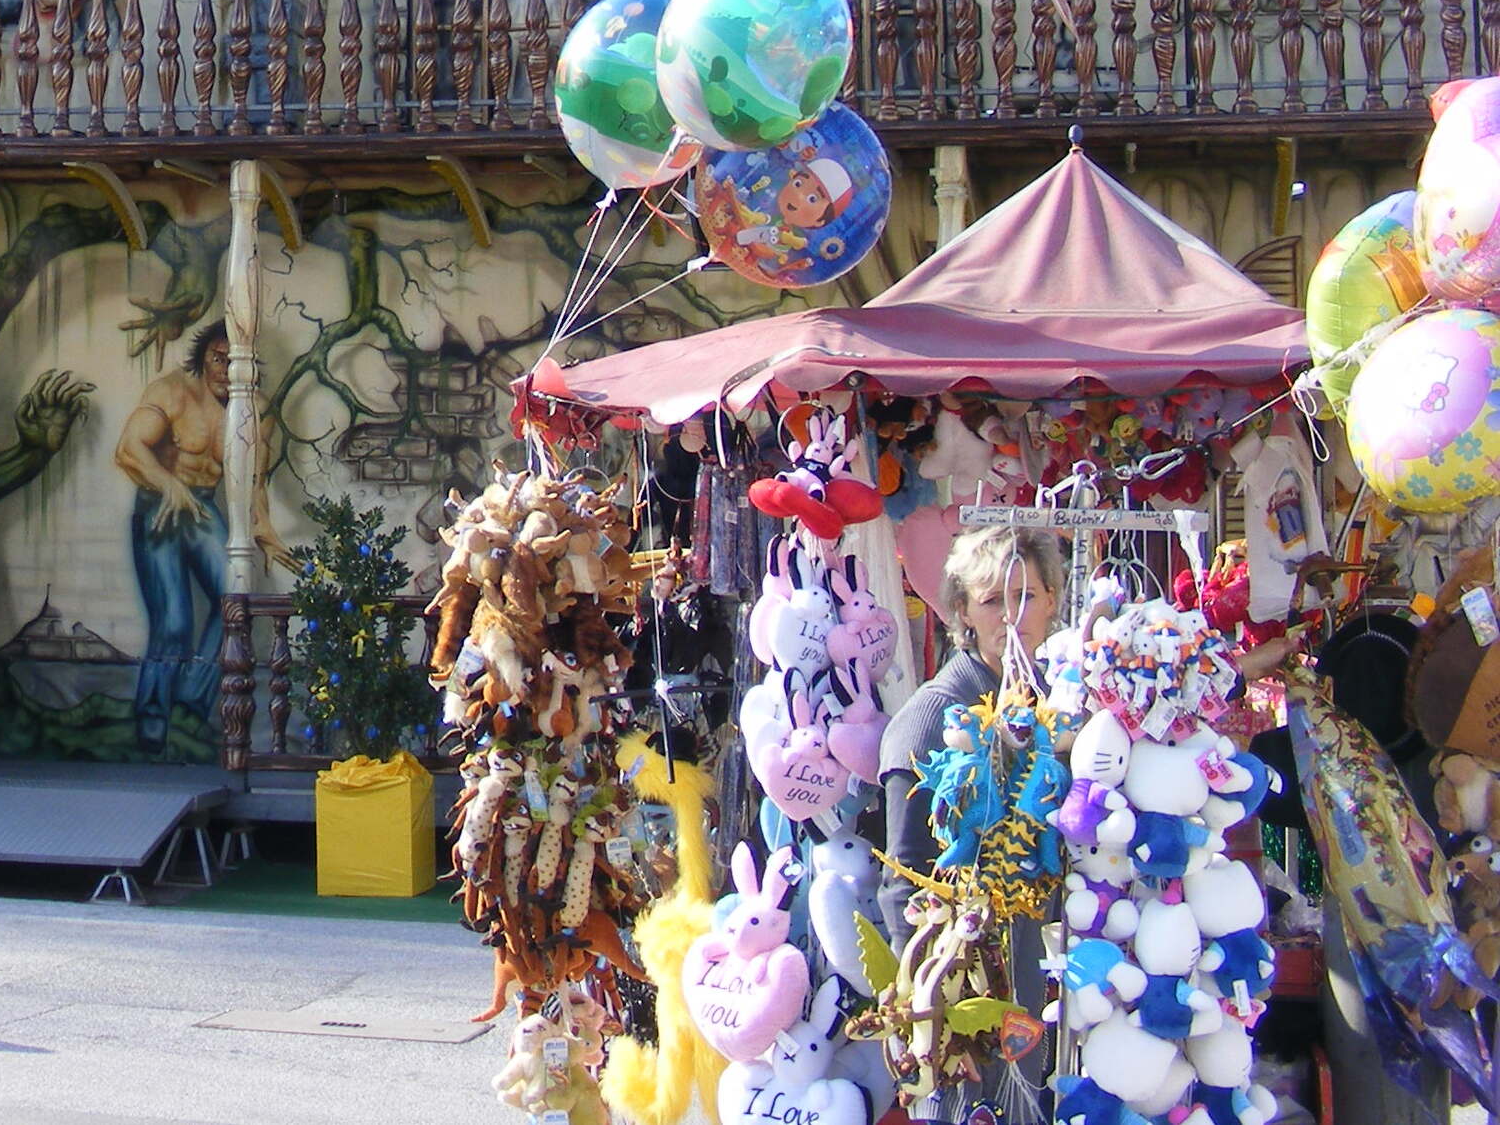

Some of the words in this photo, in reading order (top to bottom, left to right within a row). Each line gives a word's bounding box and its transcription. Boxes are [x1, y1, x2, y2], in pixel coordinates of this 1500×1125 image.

[799, 620, 808, 637] I
[808, 625, 827, 644] Lo
[855, 631, 867, 649] I
[866, 625, 894, 645] Love
[799, 646, 825, 665] you
[784, 763, 795, 778] I
[796, 764, 835, 788] Love
[784, 786, 821, 805] you
[696, 960, 720, 986] I
[743, 1087, 765, 1115] I
[761, 1092, 820, 1125] Love
